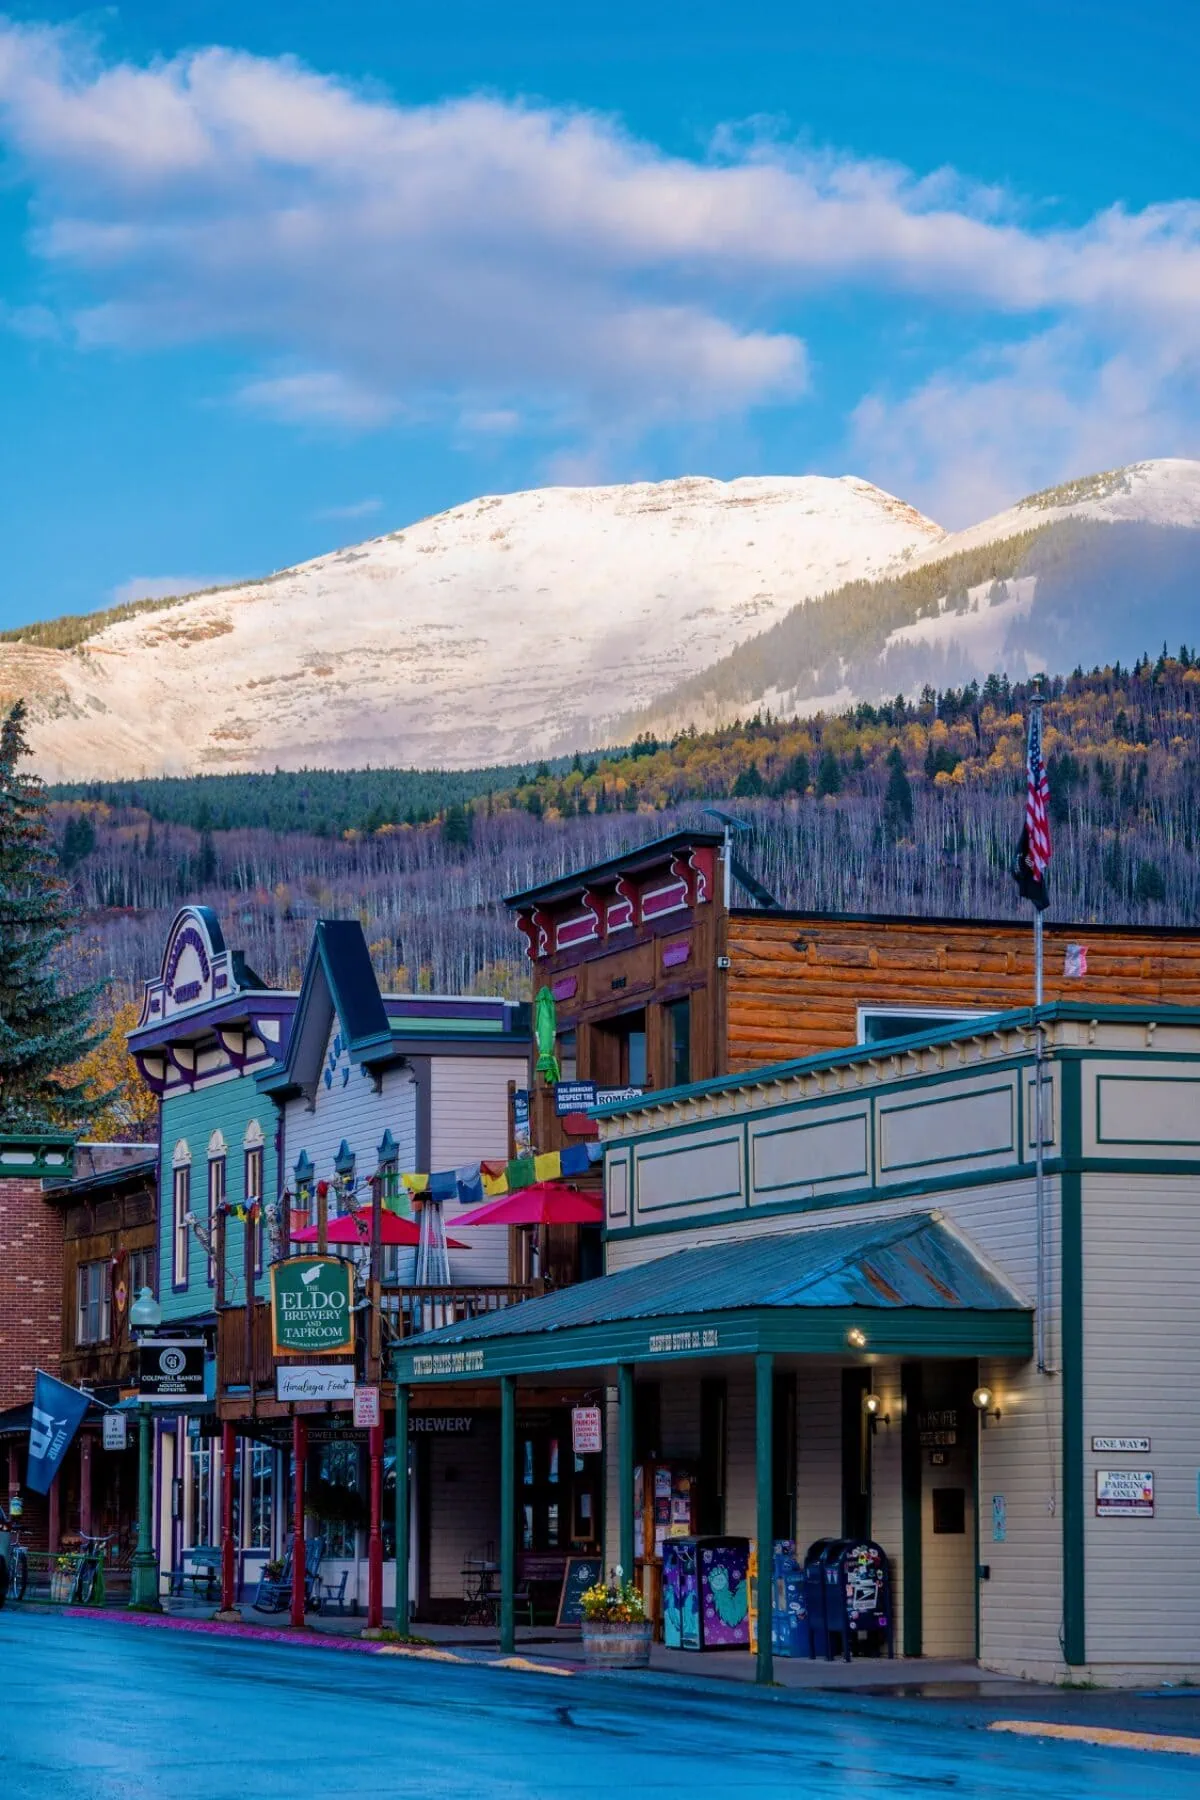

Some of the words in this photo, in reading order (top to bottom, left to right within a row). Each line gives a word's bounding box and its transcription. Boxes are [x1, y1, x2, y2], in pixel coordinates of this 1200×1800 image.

[558, 1094, 582, 1102] RESPECT
[583, 1093, 594, 1101] THE
[280, 1291, 346, 1310] ELDO
[284, 1310, 341, 1321] BREWERY
[284, 1327, 343, 1338] TAPROOM
[141, 1374, 175, 1382] COLDWELL
[176, 1374, 202, 1382] BANKER
[282, 1379, 324, 1396] Himalaya
[327, 1380, 348, 1391] Food
[1095, 1439, 1117, 1448] ONE
[1119, 1440, 1139, 1449] WAY
[1104, 1481, 1146, 1489] PARKING
[1112, 1489, 1138, 1497] ONLY
